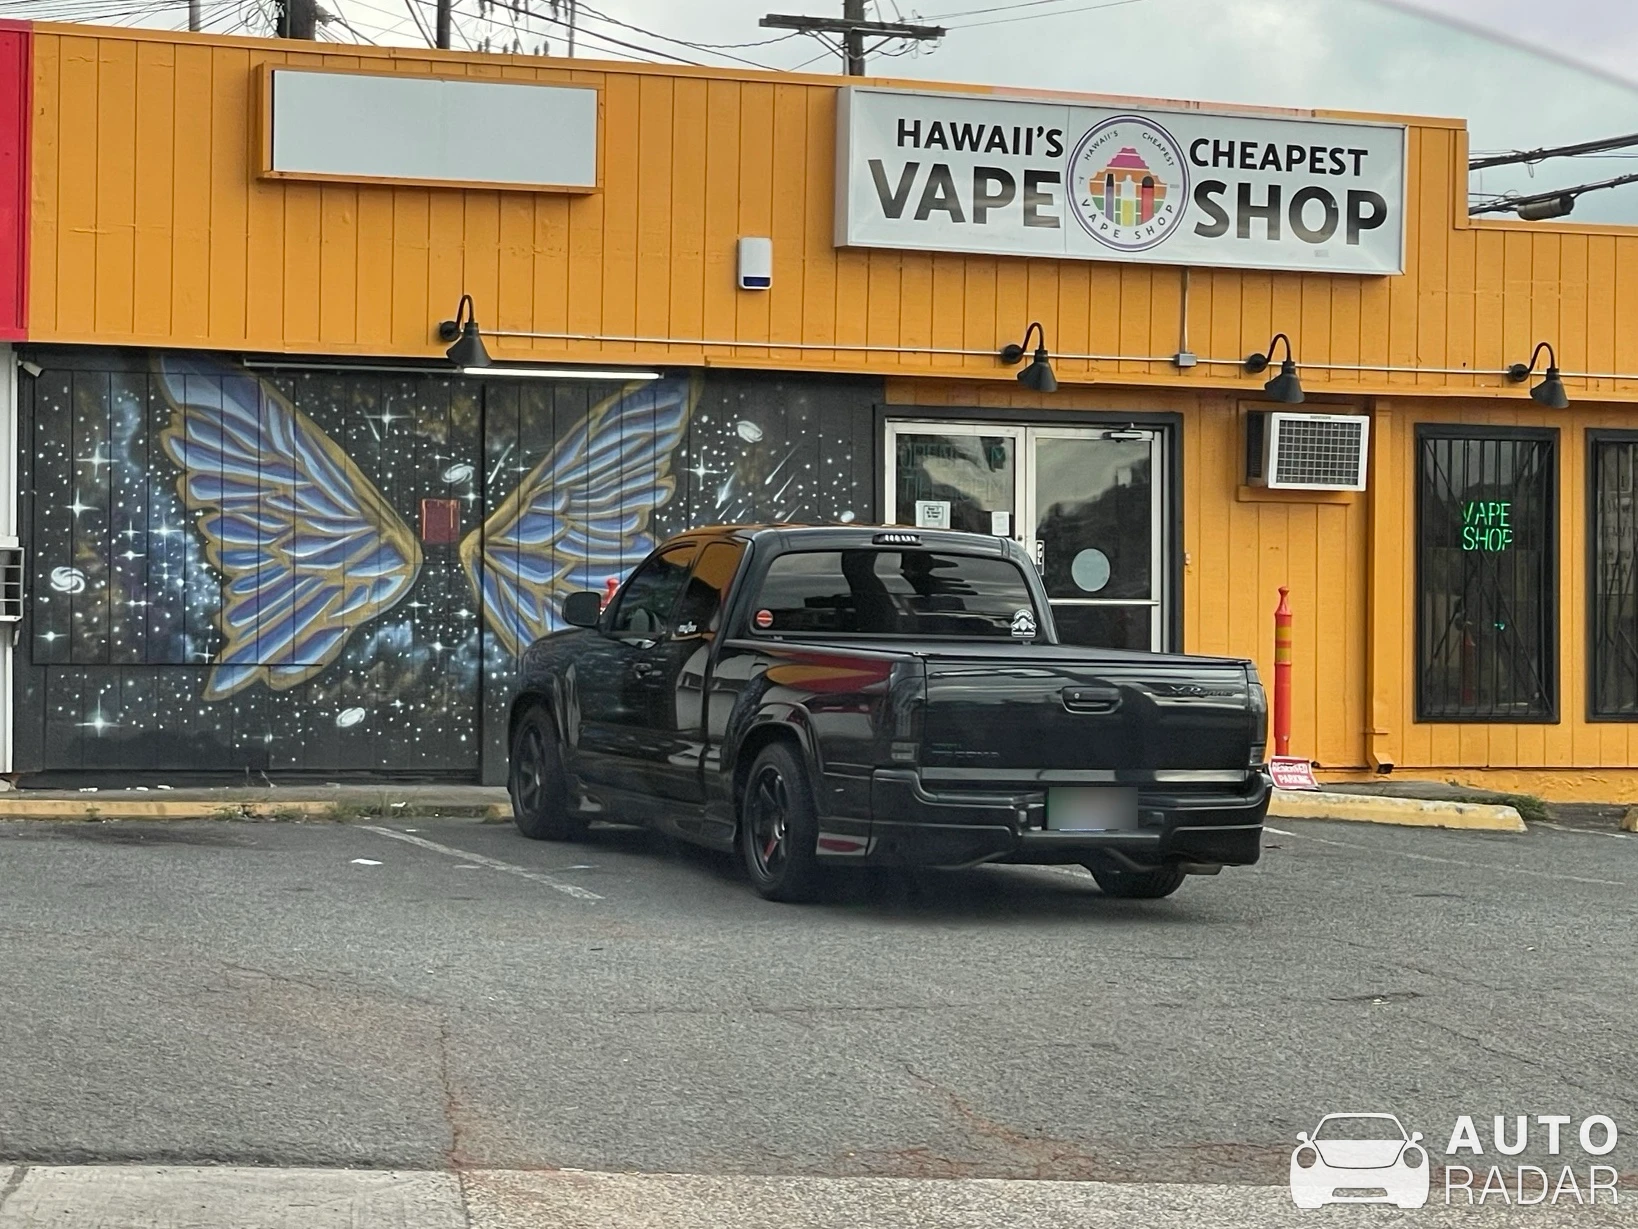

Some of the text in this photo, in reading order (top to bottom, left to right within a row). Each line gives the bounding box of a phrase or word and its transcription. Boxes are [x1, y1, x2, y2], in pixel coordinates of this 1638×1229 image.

[898, 118, 1369, 177] HAWAII'S CHEAPEST
[1084, 129, 1175, 167] HAWAII'S CHEAPEST
[868, 159, 1388, 245] VAPE SHOP
[1081, 198, 1174, 240] VAPE SHOP
[1461, 501, 1512, 527] VAPE
[1463, 526, 1513, 552] SHOP
[1277, 773, 1312, 785] PARKING
